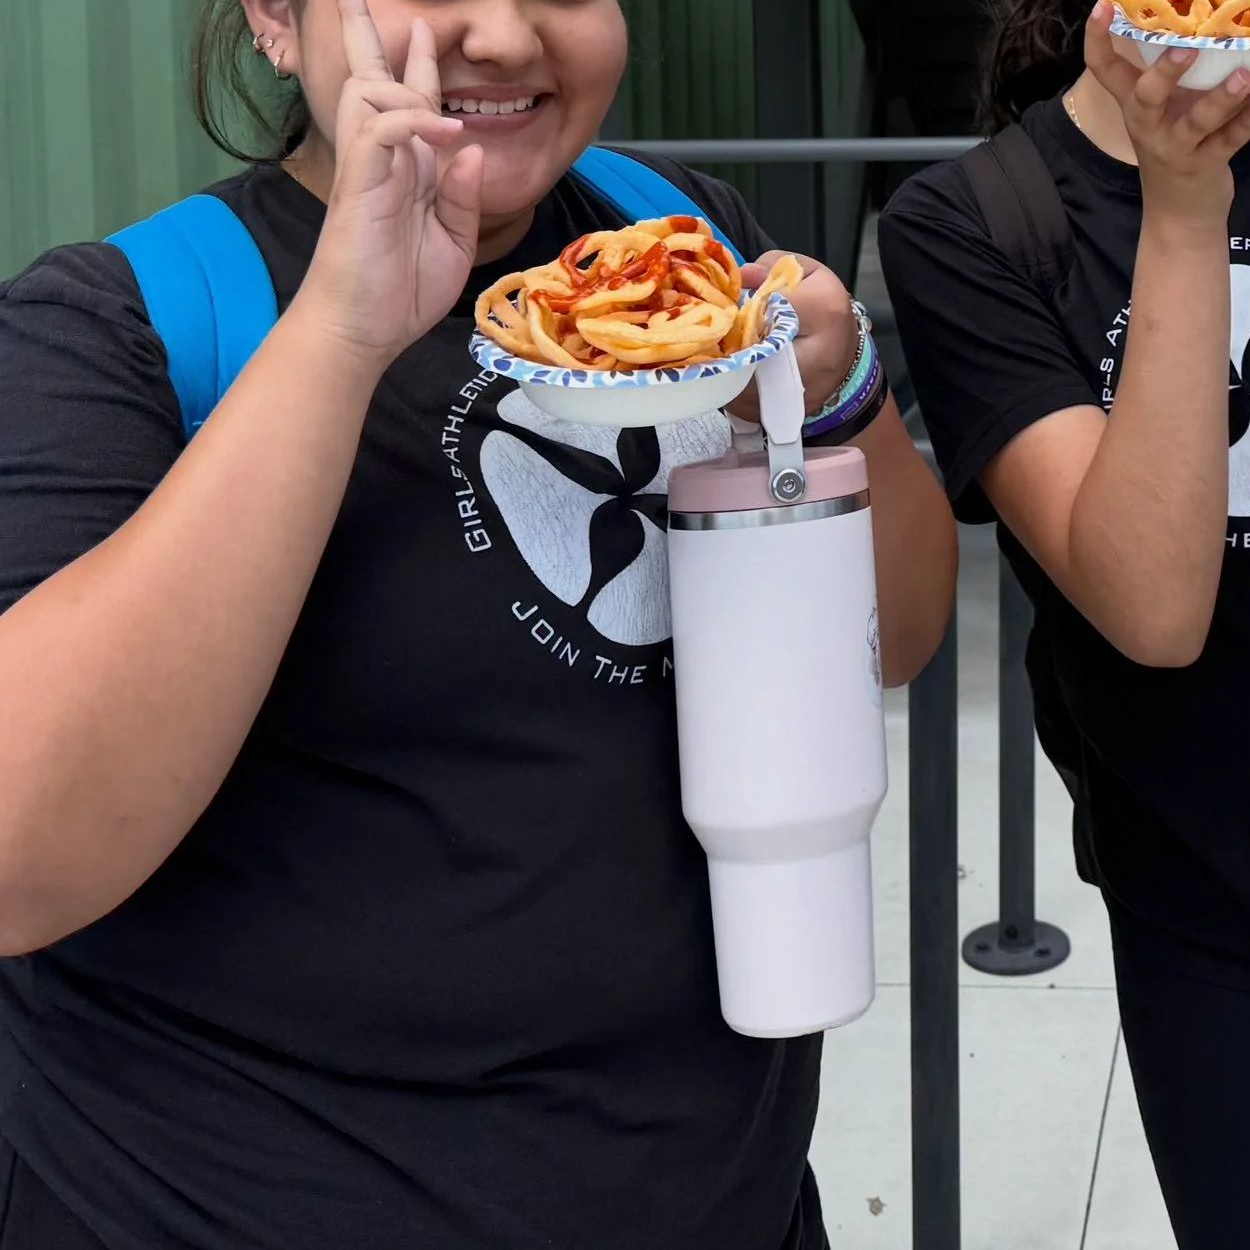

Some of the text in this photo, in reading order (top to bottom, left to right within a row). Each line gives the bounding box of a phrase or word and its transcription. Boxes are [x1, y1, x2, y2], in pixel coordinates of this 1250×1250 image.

[1099, 358, 1115, 409] IRLS
[441, 368, 498, 552] GIRLS ATHLETIC
[511, 601, 581, 667] JOIN
[594, 655, 647, 684] THE
